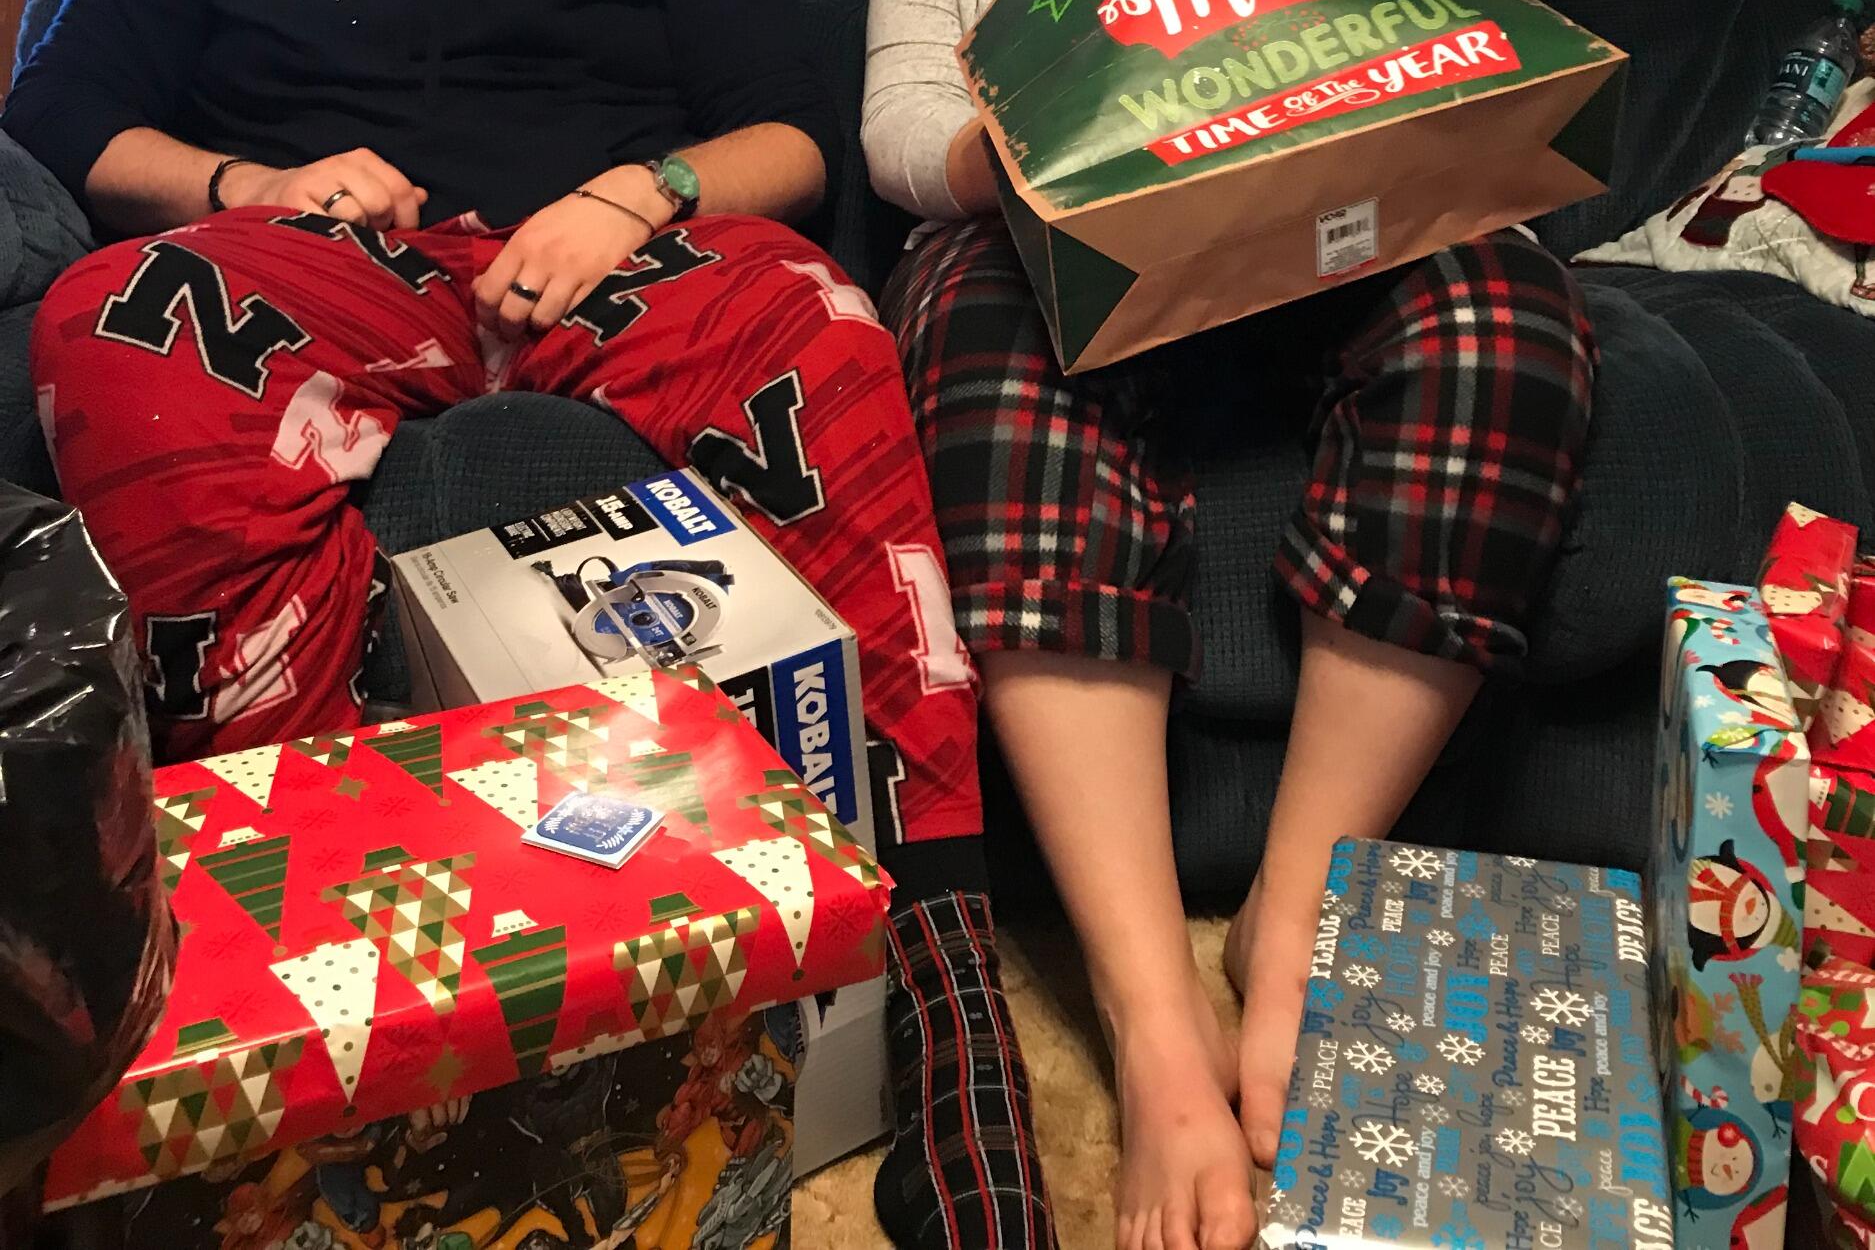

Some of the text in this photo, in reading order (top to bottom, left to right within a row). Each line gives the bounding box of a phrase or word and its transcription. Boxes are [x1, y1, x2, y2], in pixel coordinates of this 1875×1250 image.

[1163, 105, 1286, 154] TIME
[94, 238, 314, 402] N
[645, 478, 717, 535] KOBALT
[691, 586, 718, 610] KOBALT
[1443, 866, 1456, 888] and
[1382, 899, 1405, 933] PEACE
[1441, 888, 1455, 919] peace
[1490, 933, 1509, 977] PEACE
[1542, 913, 1560, 957] PEACE
[1422, 947, 1442, 1027] peace and joy
[1593, 1012, 1608, 1036] and
[1312, 1039, 1339, 1091] PEACE
[1595, 1037, 1612, 1075] peace
[1531, 1054, 1577, 1141] PEACE
[1308, 1110, 1346, 1160] Hope
[1412, 1126, 1437, 1229] peace and joy
[1599, 1148, 1633, 1197] peace
[1339, 1196, 1367, 1239] EACE
